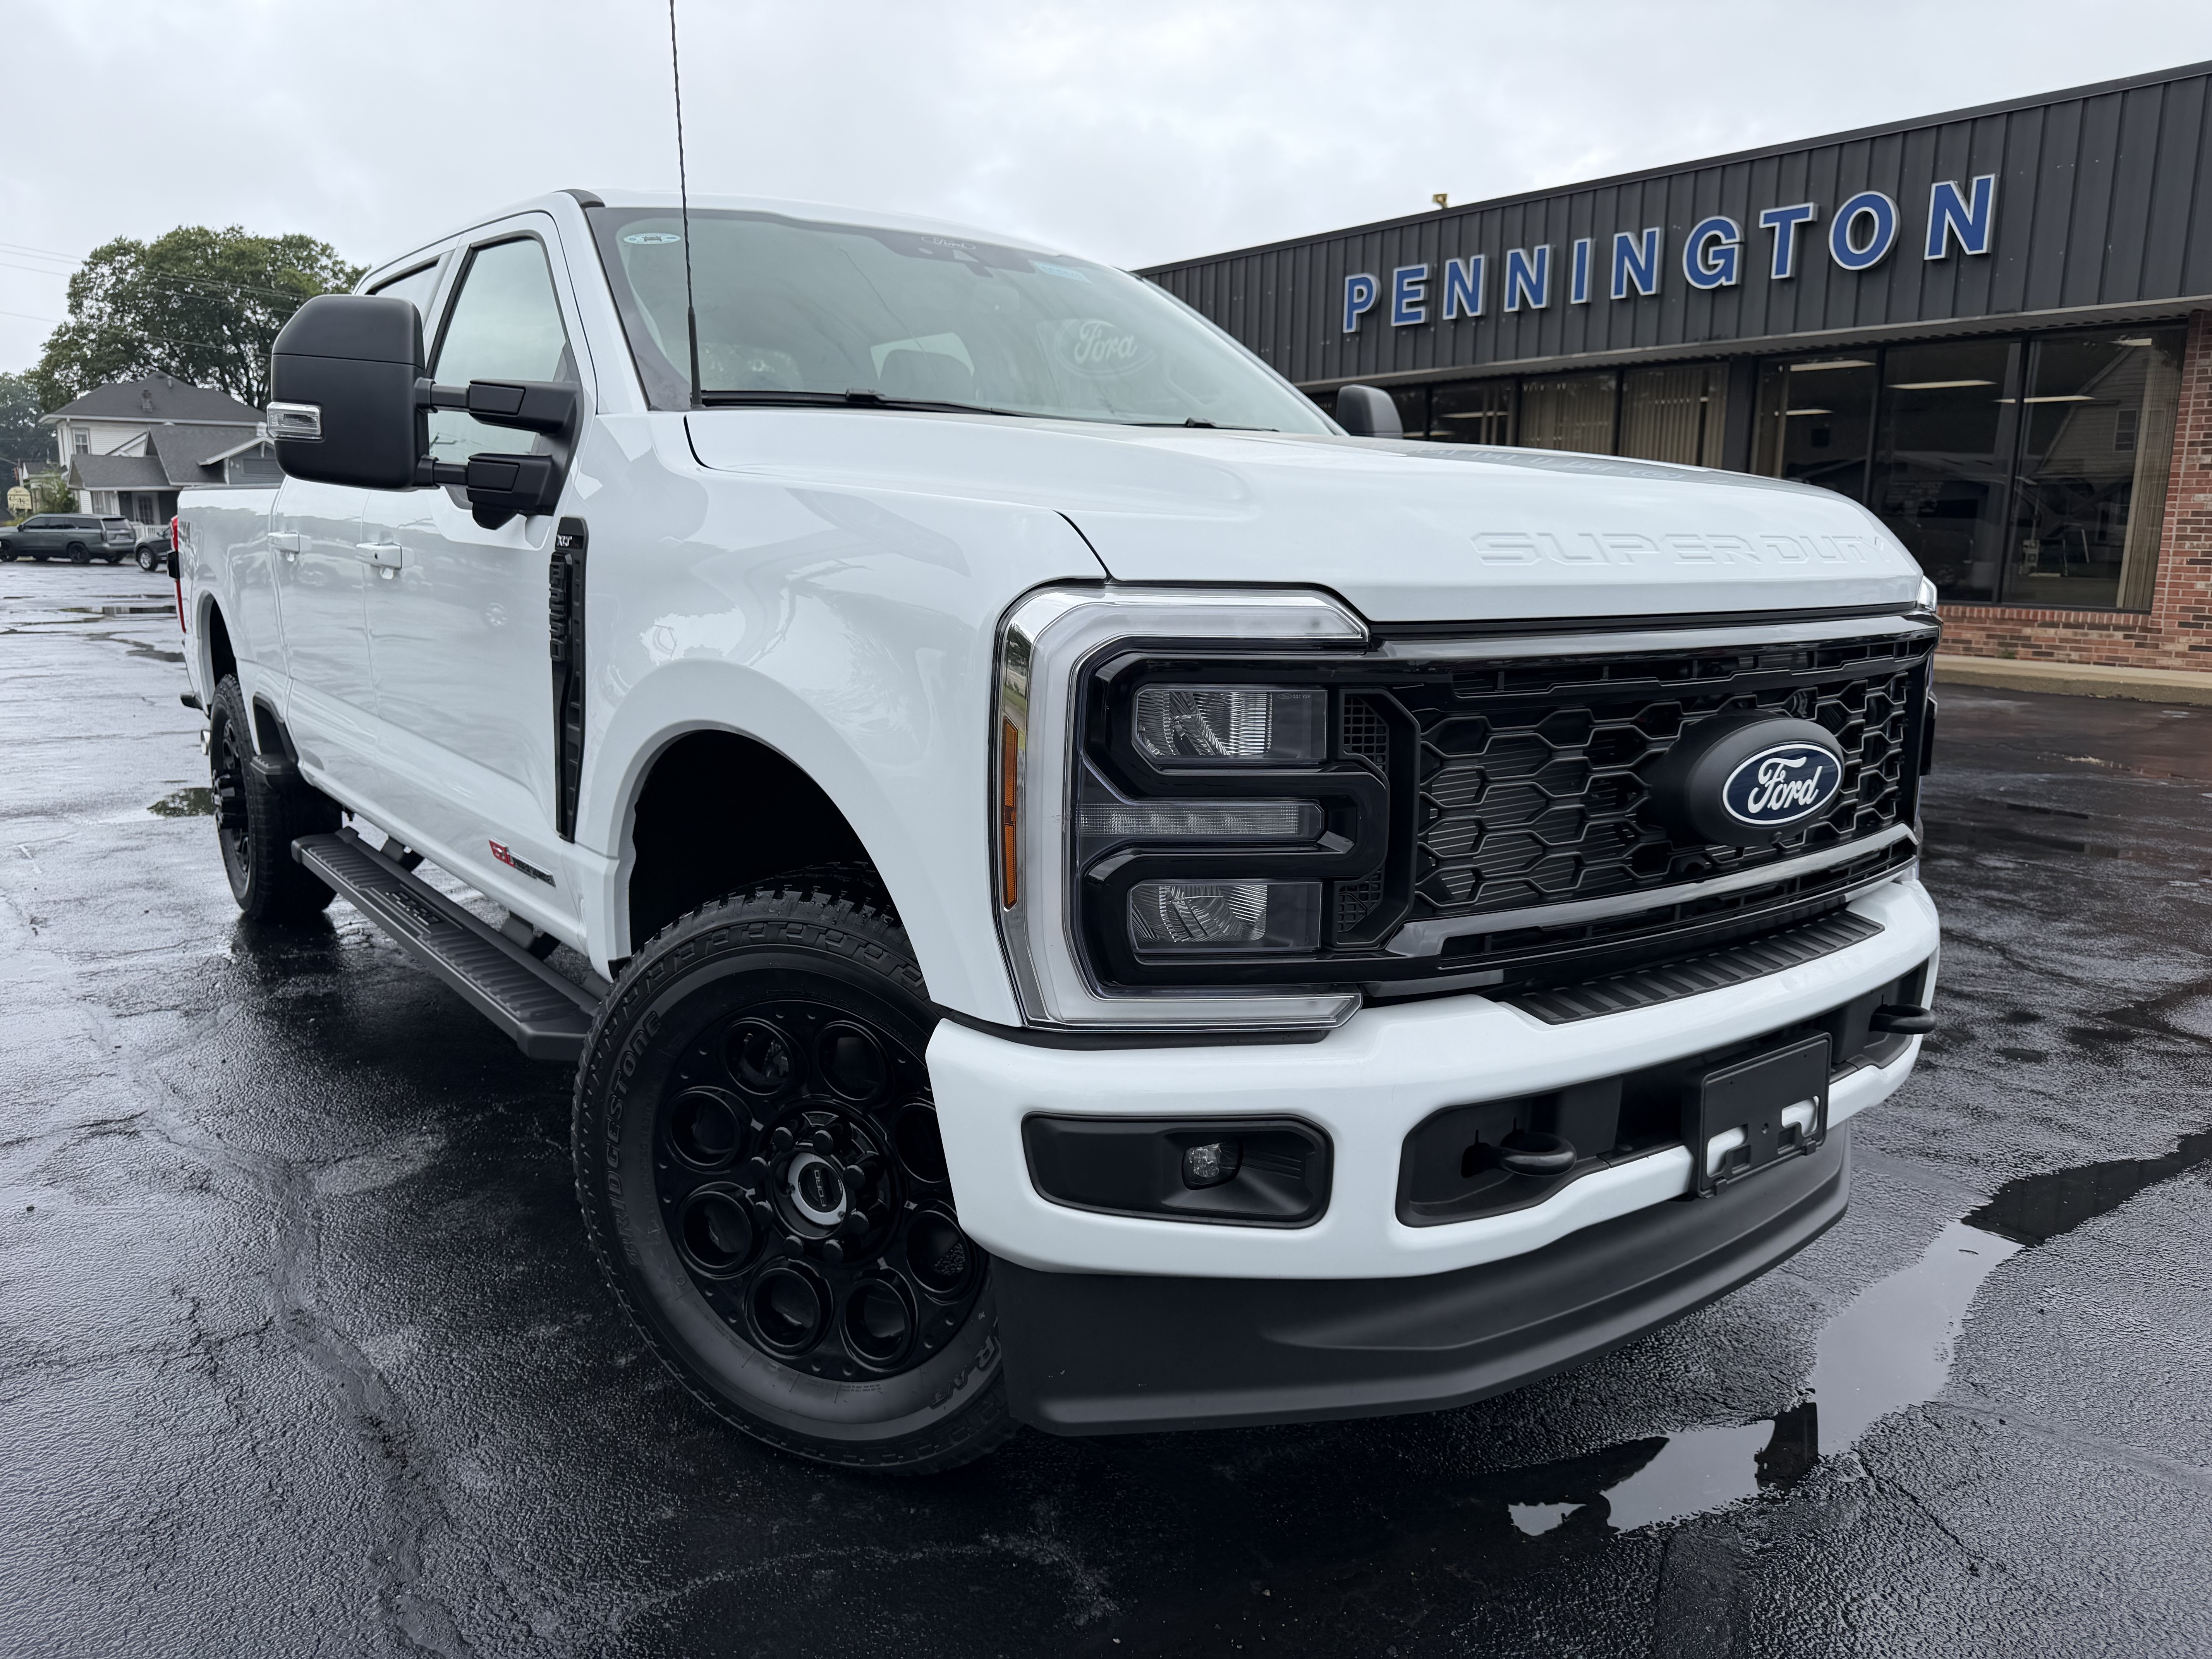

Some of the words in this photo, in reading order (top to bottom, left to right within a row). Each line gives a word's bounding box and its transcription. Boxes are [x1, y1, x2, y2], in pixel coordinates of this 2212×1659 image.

[1342, 173, 1999, 334] PENNINGTON
[556, 534, 573, 547] XLT
[1470, 532, 1762, 566] SUPER
[1759, 534, 1892, 565] DUTY
[1747, 756, 1823, 814] Ford
[606, 1010, 661, 1267] BRIDGESTONE
[814, 1169, 827, 1207] FORD
